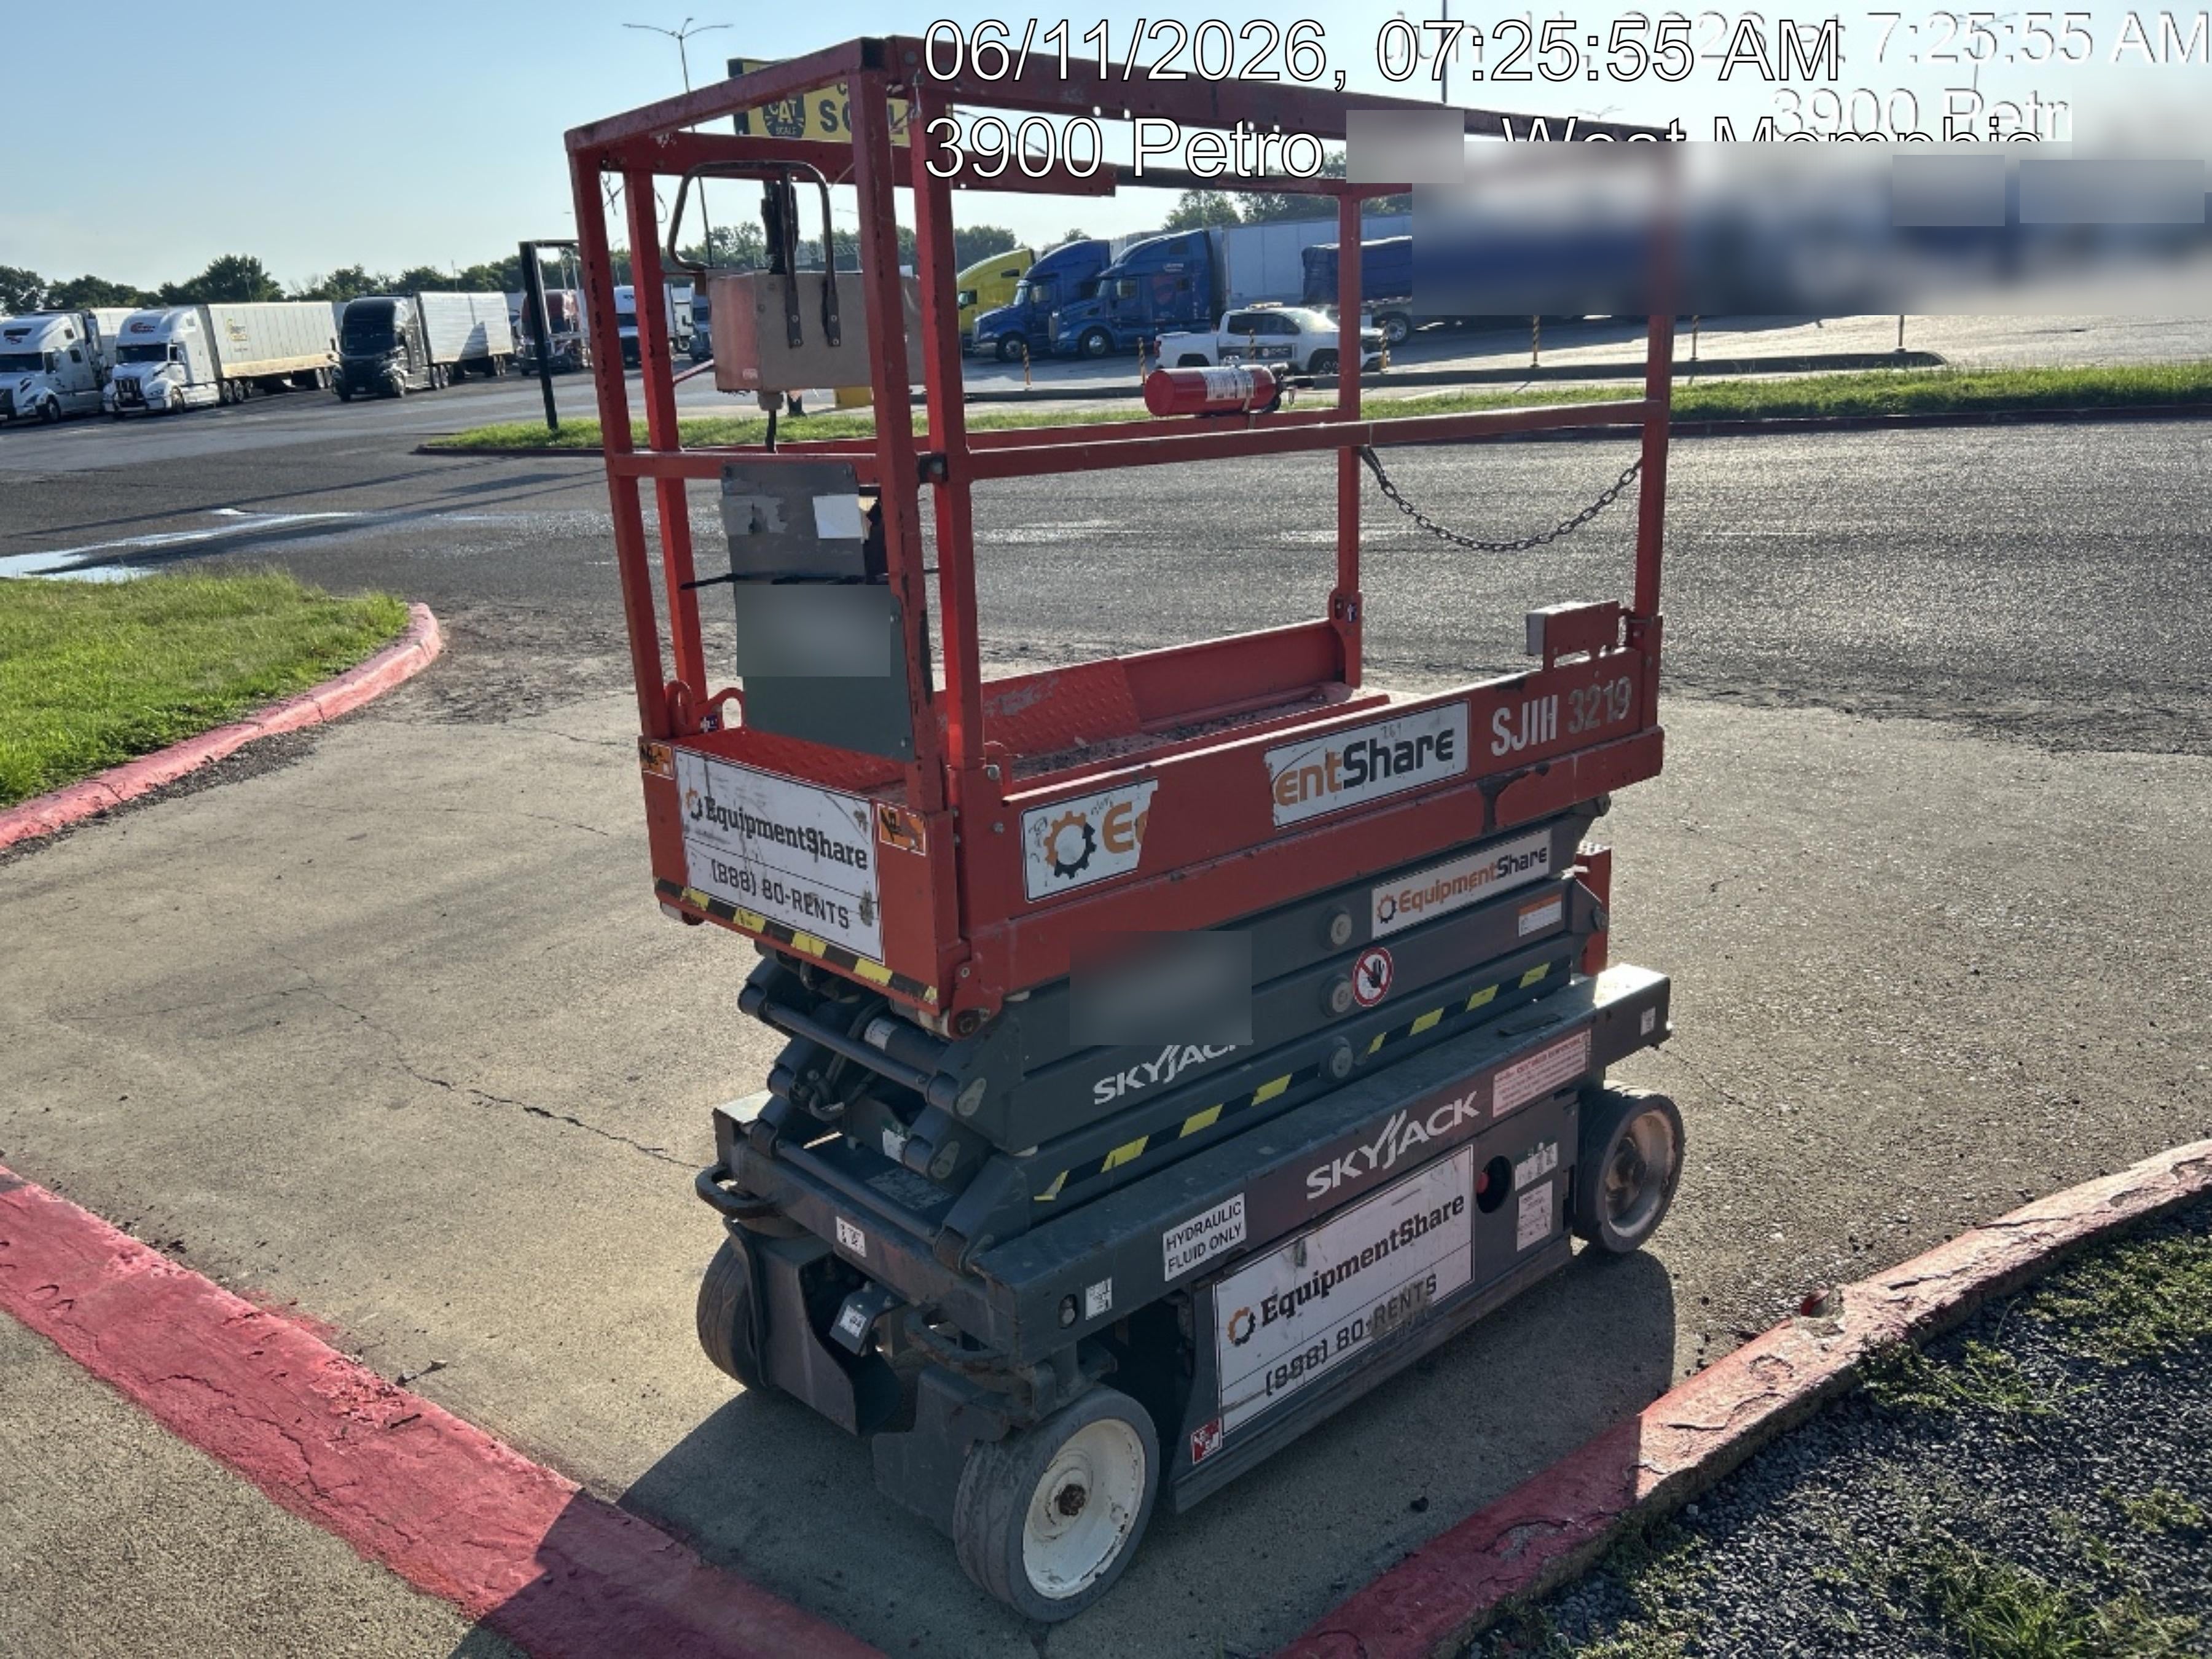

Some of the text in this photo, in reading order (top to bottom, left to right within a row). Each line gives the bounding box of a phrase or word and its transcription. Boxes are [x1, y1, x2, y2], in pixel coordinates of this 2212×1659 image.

[769, 98, 797, 124] CAT
[1567, 676, 1632, 734] 3219
[705, 797, 868, 871] EquipmentShare
[711, 858, 850, 930] (888) 80-RENTS
[1398, 846, 1548, 912] EquipmentShare
[1094, 1045, 1236, 1105] SKYJAC
[1306, 1090, 1481, 1201] SKYJACK
[1166, 1201, 1242, 1252] HYDRAULIC
[1168, 1222, 1242, 1273] FLUID ONLY
[1260, 1193, 1465, 1327] EquipmentShare
[1265, 1273, 1438, 1397] (888) 80-RENTS
